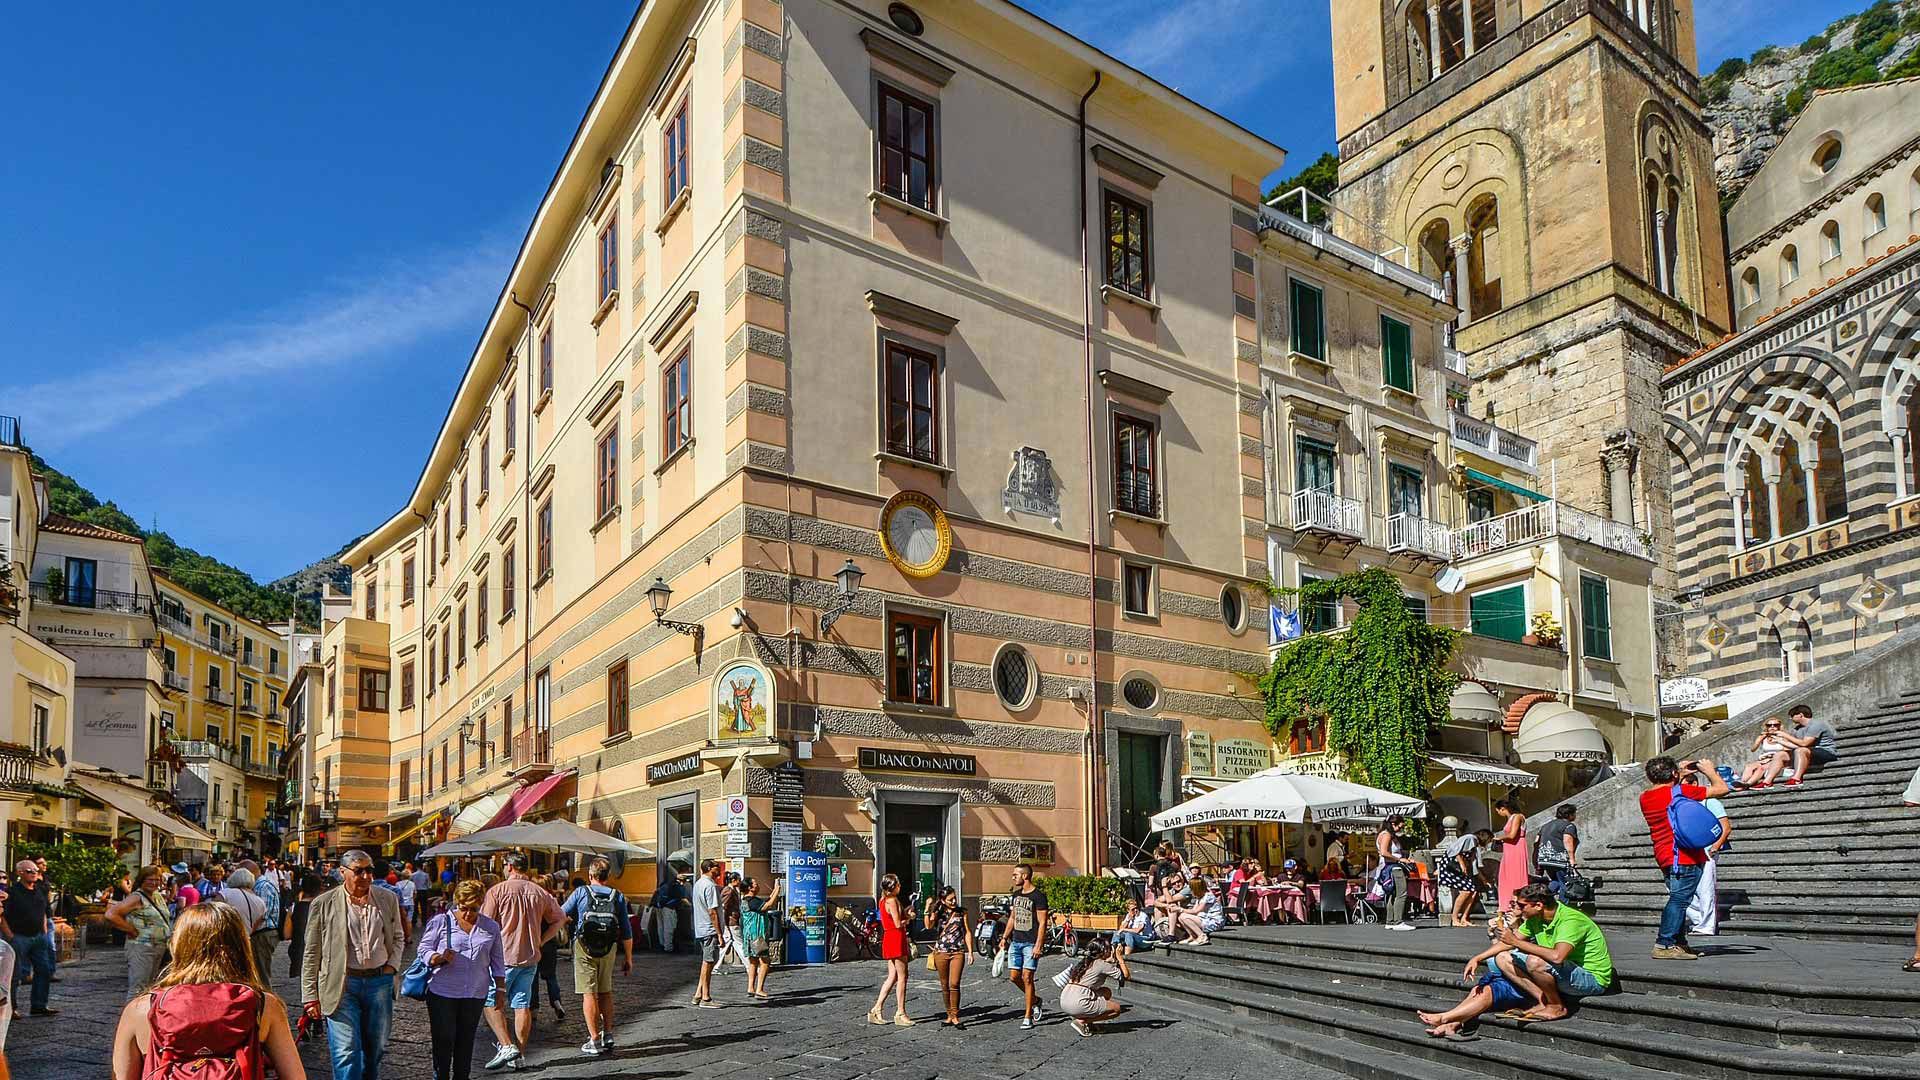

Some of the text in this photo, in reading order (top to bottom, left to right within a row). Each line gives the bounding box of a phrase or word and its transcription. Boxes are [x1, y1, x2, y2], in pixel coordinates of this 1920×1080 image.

[37, 625, 115, 639] residenza luce
[1662, 692, 1708, 702] CHIOSTRO
[1218, 745, 1268, 758] RISTORANTE
[1554, 751, 1597, 759] PIZZERIA
[653, 762, 672, 778] BANCO
[677, 755, 699, 773] NAPOLI
[879, 753, 974, 772] BANCO DI NAPOLI
[1225, 756, 1262, 768] PIZZERIA
[1289, 762, 1347, 773] TORANTE
[1222, 766, 1258, 776] S. ANDR
[1458, 770, 1501, 783] RISTORANTE
[1163, 808, 1287, 828] BAR RESTAURANT PIZZA
[1317, 805, 1348, 819] LIGHT
[1385, 805, 1416, 817] PIZZA
[1329, 821, 1373, 832] RISTORANTE
[789, 855, 826, 866] Info Point
